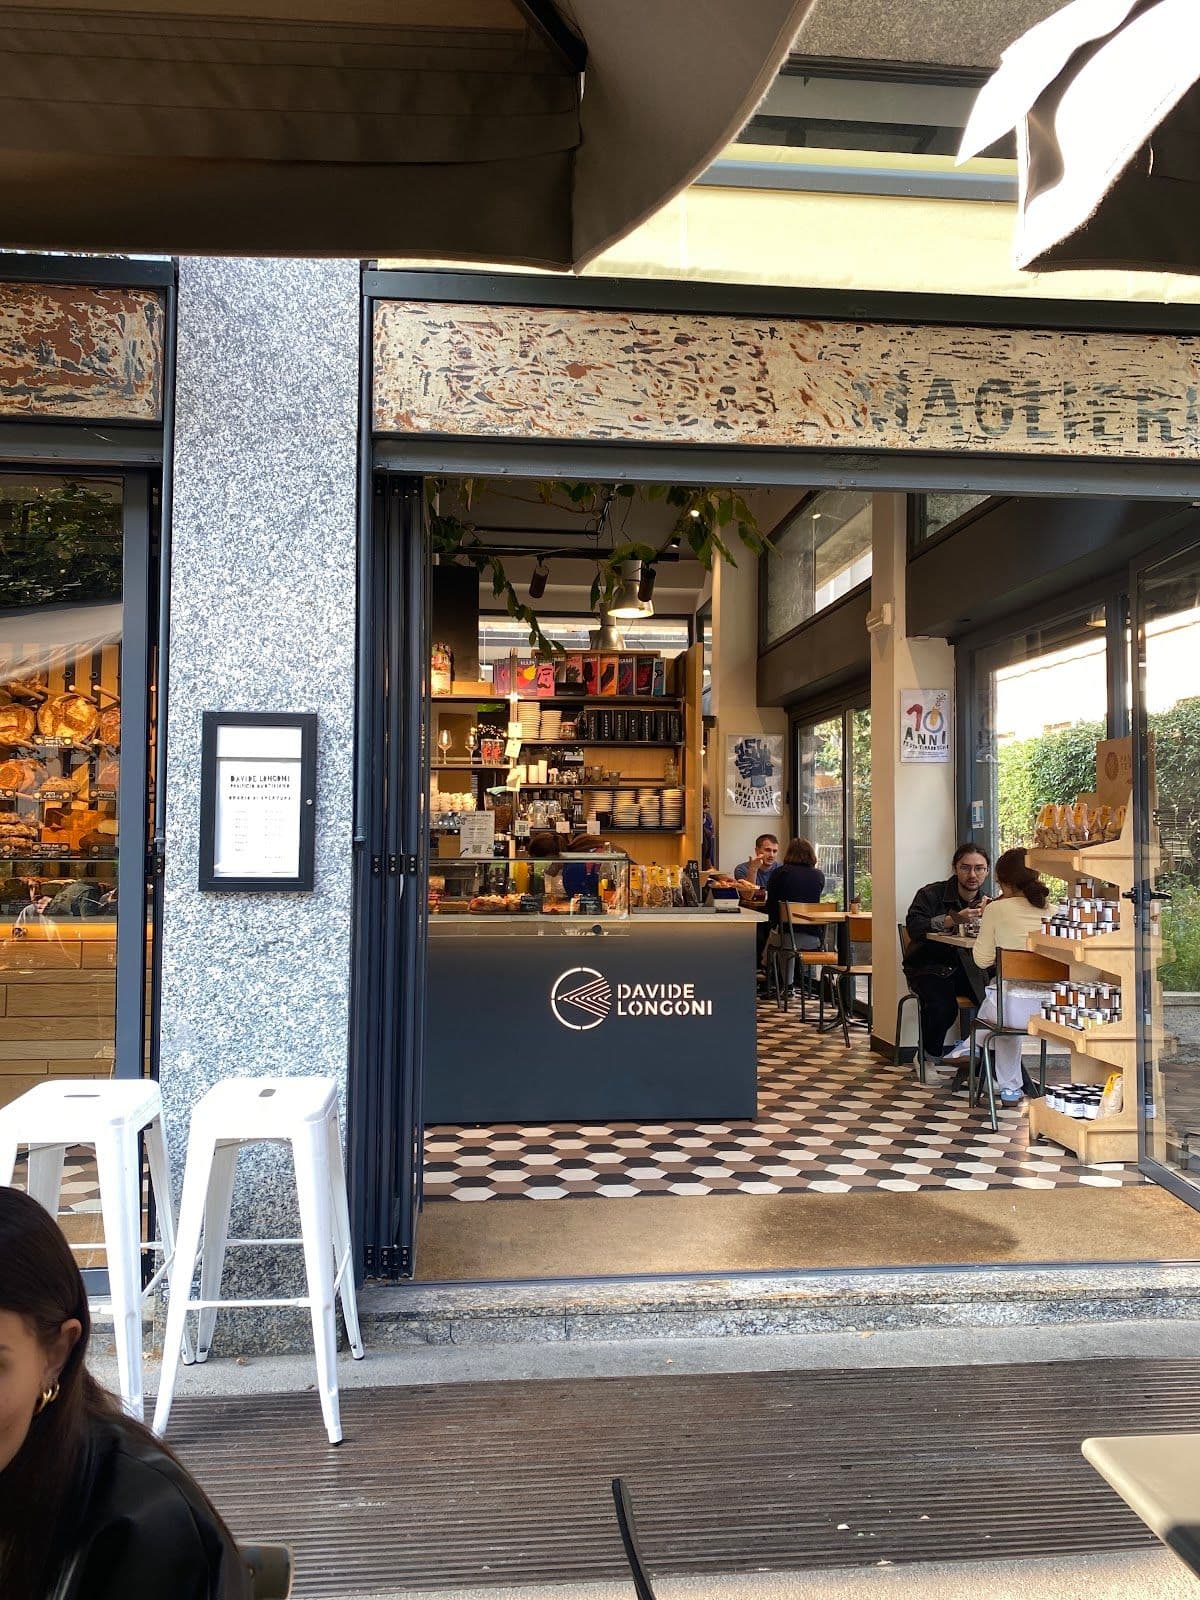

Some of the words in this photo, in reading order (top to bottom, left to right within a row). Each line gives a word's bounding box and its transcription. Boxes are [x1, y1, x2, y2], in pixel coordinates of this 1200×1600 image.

[906, 703, 944, 733] 10
[905, 727, 946, 746] ANNI
[617, 983, 695, 999] DAVIDE
[617, 999, 713, 1016] LONGONI
